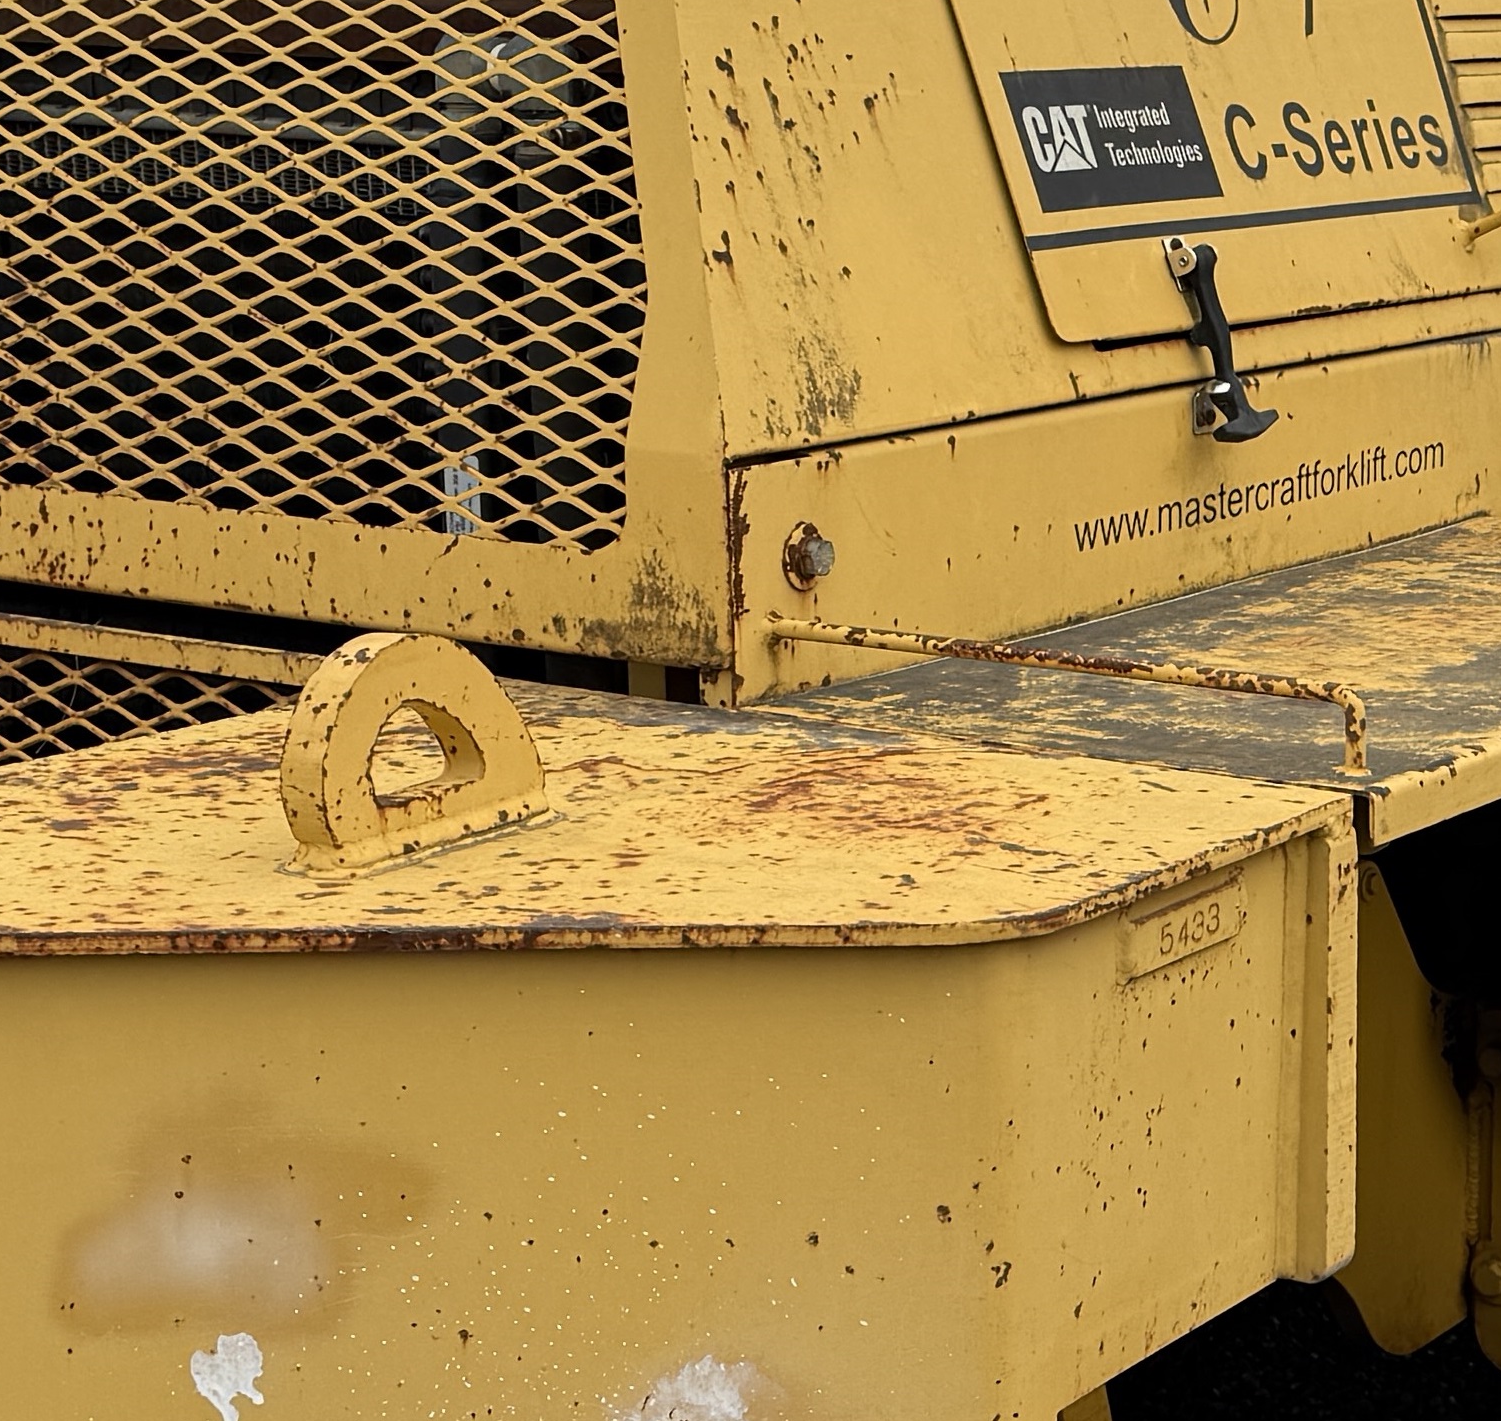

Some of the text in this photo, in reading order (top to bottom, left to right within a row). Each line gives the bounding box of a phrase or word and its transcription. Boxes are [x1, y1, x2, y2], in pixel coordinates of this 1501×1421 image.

[1022, 105, 1098, 173] CAT
[1094, 102, 1169, 130] Integrated
[1224, 100, 1449, 180] C-Series
[1104, 140, 1204, 169] Technologies
[1074, 441, 1444, 552] www.mastercraftforklift.com
[1159, 902, 1221, 956] 5433
